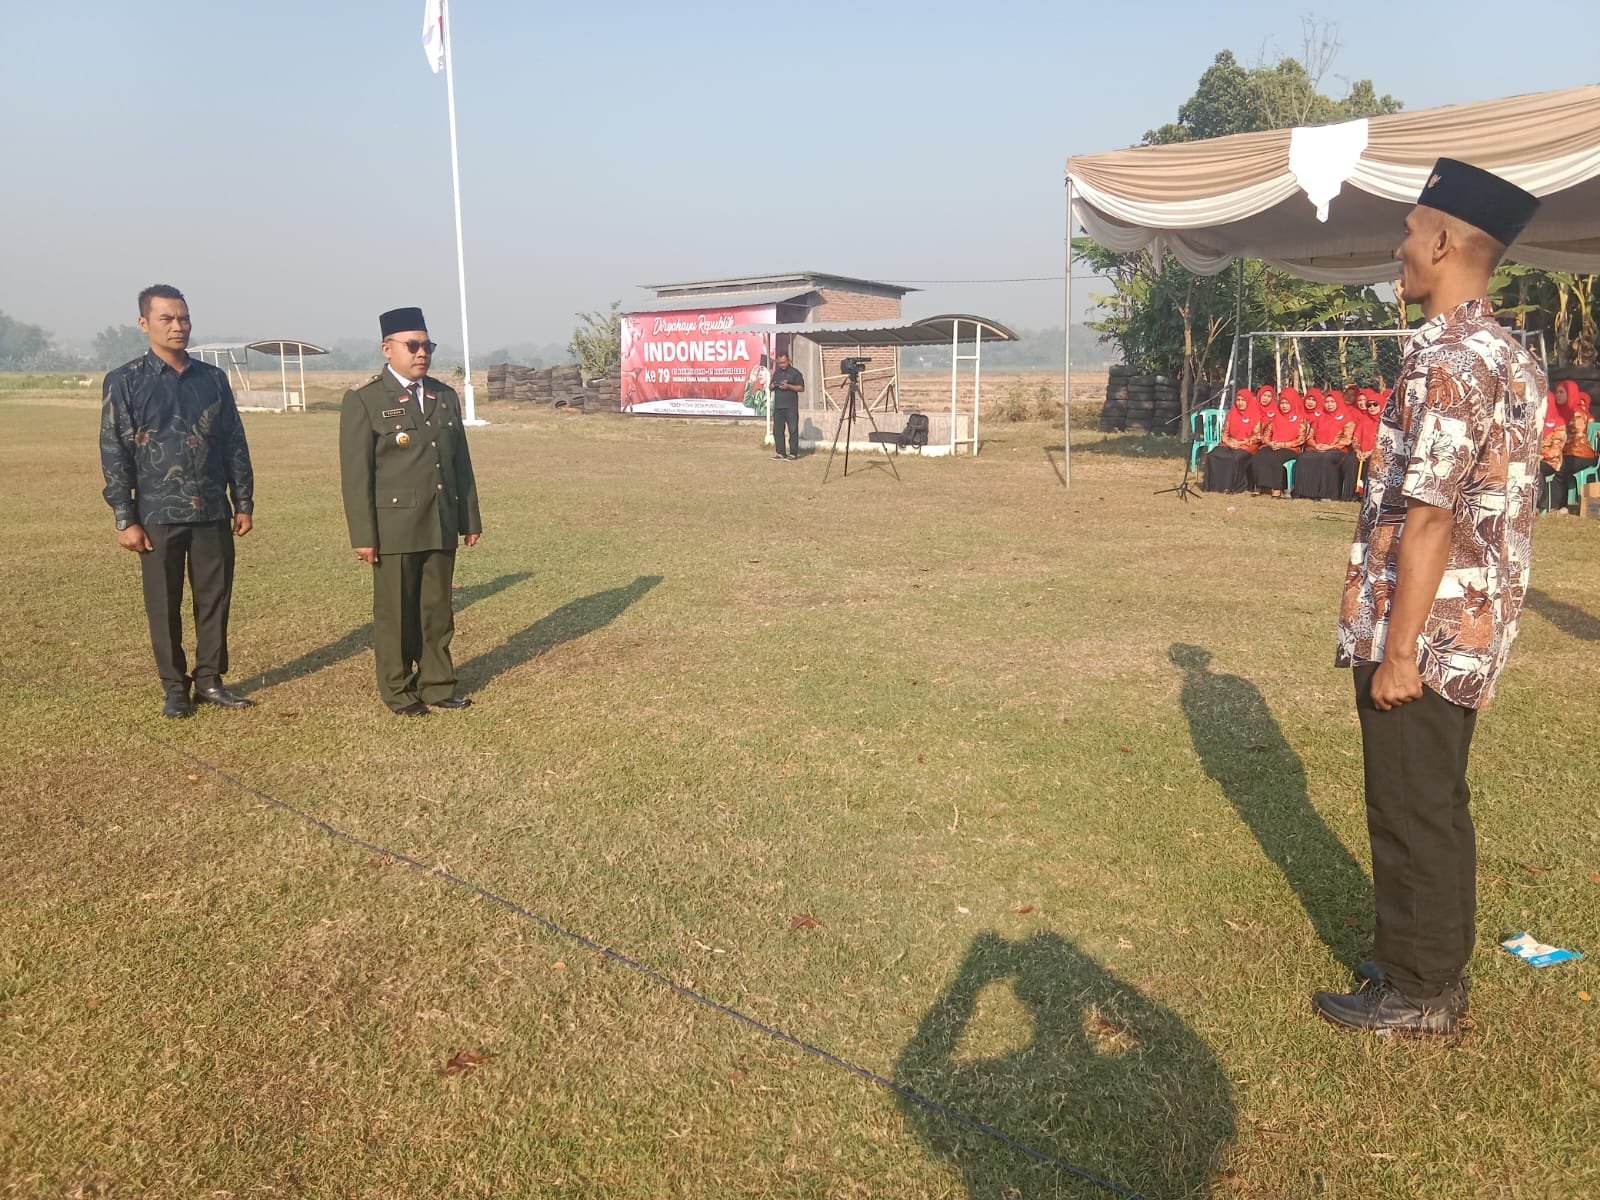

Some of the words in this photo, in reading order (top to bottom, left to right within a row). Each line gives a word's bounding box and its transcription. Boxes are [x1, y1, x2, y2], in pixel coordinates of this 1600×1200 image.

[652, 316, 697, 336] Dirgahayu
[698, 314, 734, 335] Republik
[643, 339, 750, 362] INDONESIA
[658, 368, 670, 383] 79
